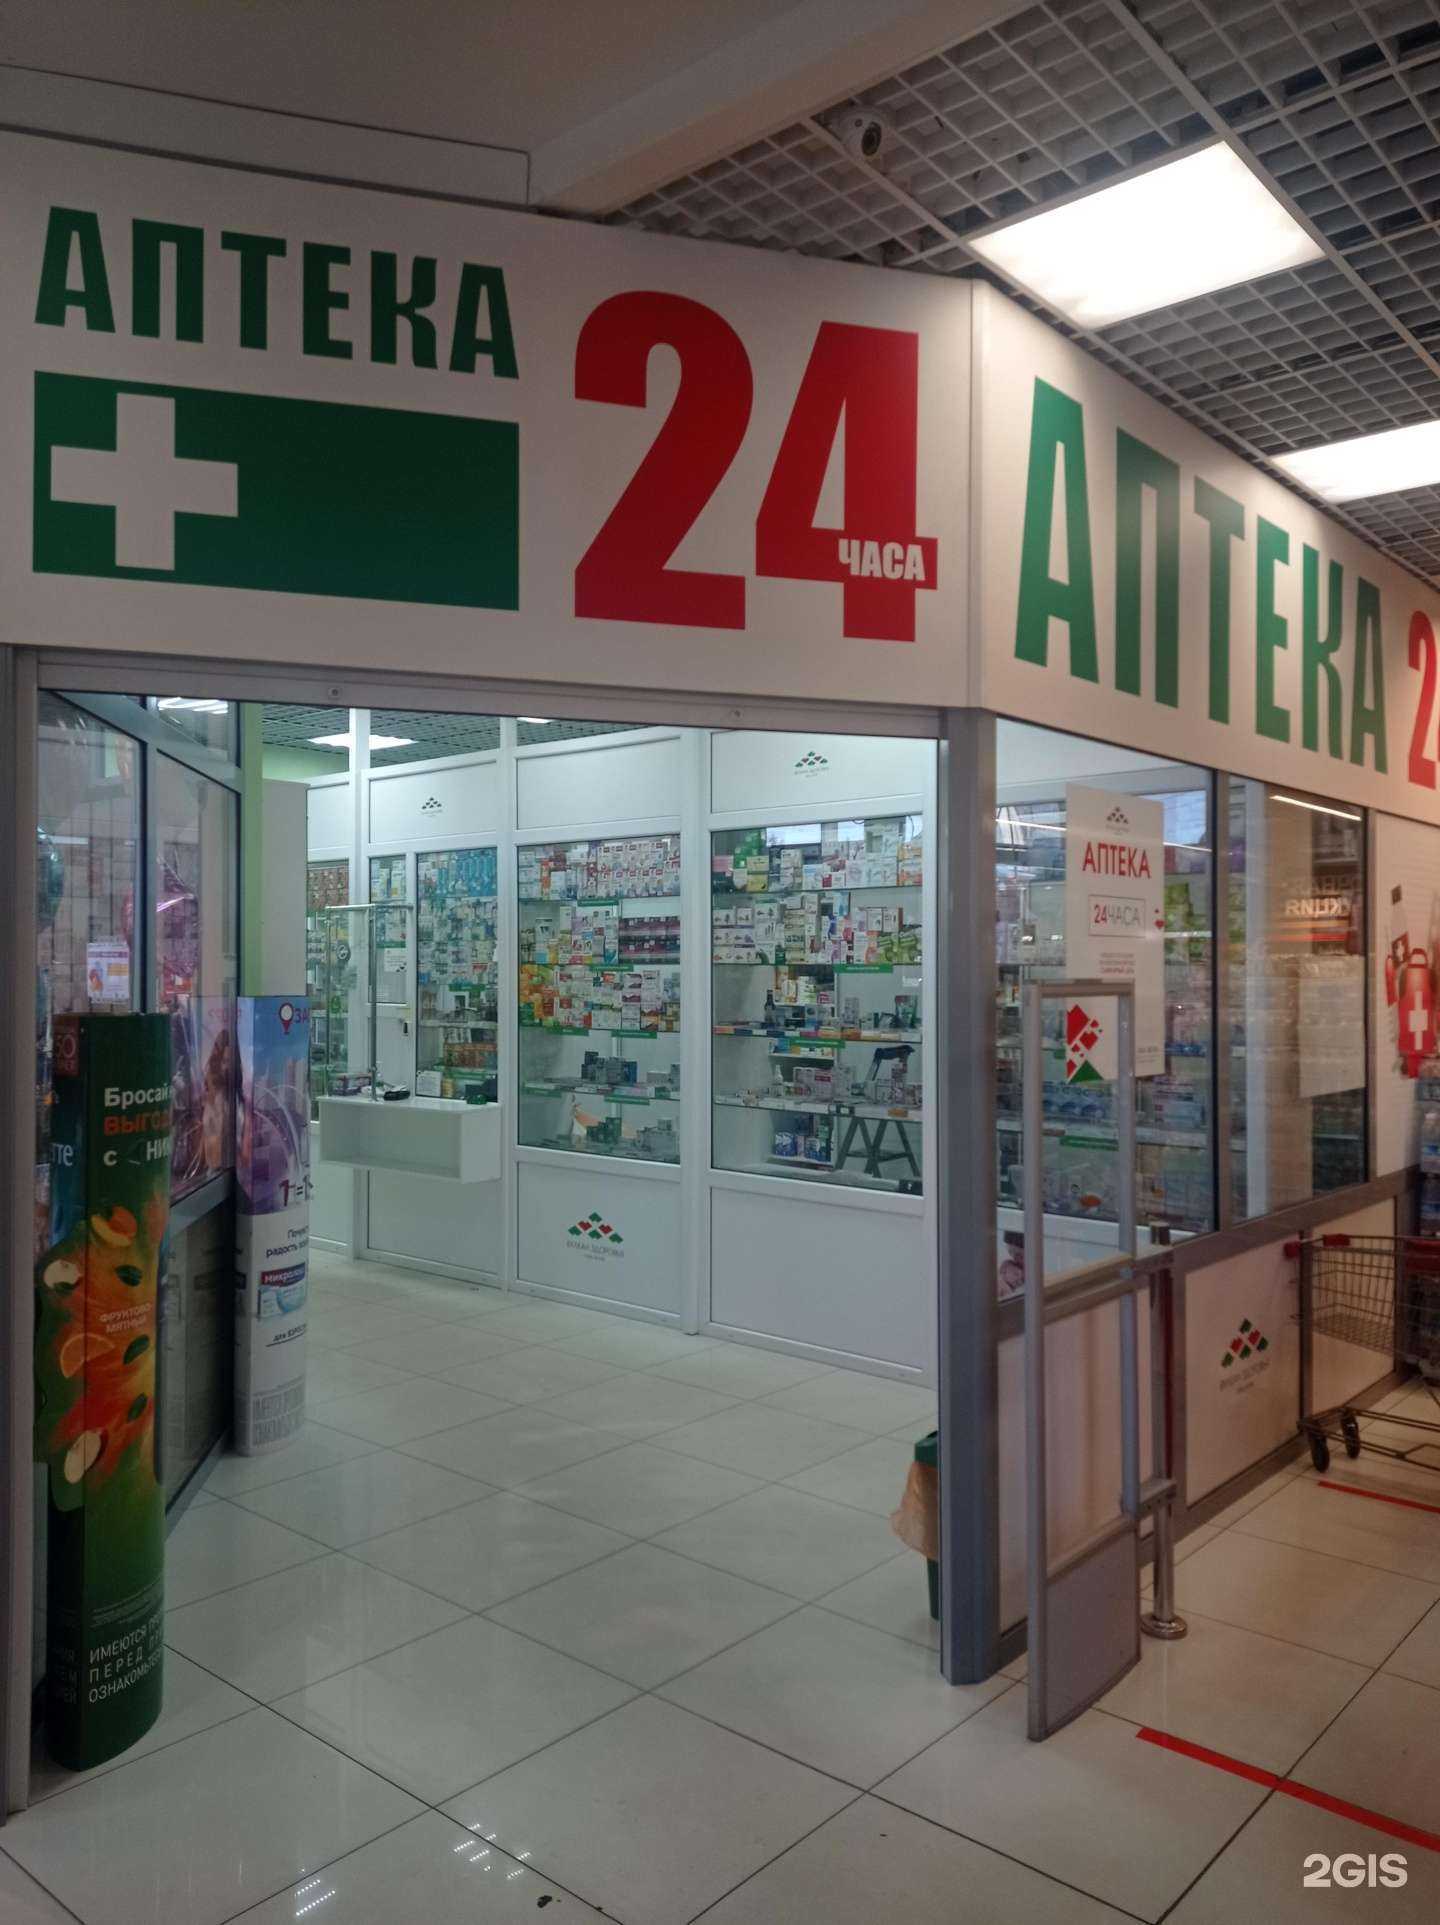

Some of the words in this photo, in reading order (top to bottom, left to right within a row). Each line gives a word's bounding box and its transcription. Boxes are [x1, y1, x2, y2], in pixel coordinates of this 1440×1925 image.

[34, 205, 519, 380] АПТЕКА
[574, 290, 938, 642] 24
[838, 538, 926, 582] ЧАСА
[1013, 376, 1389, 775] АПТЕКА
[1408, 610, 1440, 791] 2
[1082, 841, 1152, 880] АПТЕКА
[89, 1623, 147, 1664] ИМЕЮТСЯ
